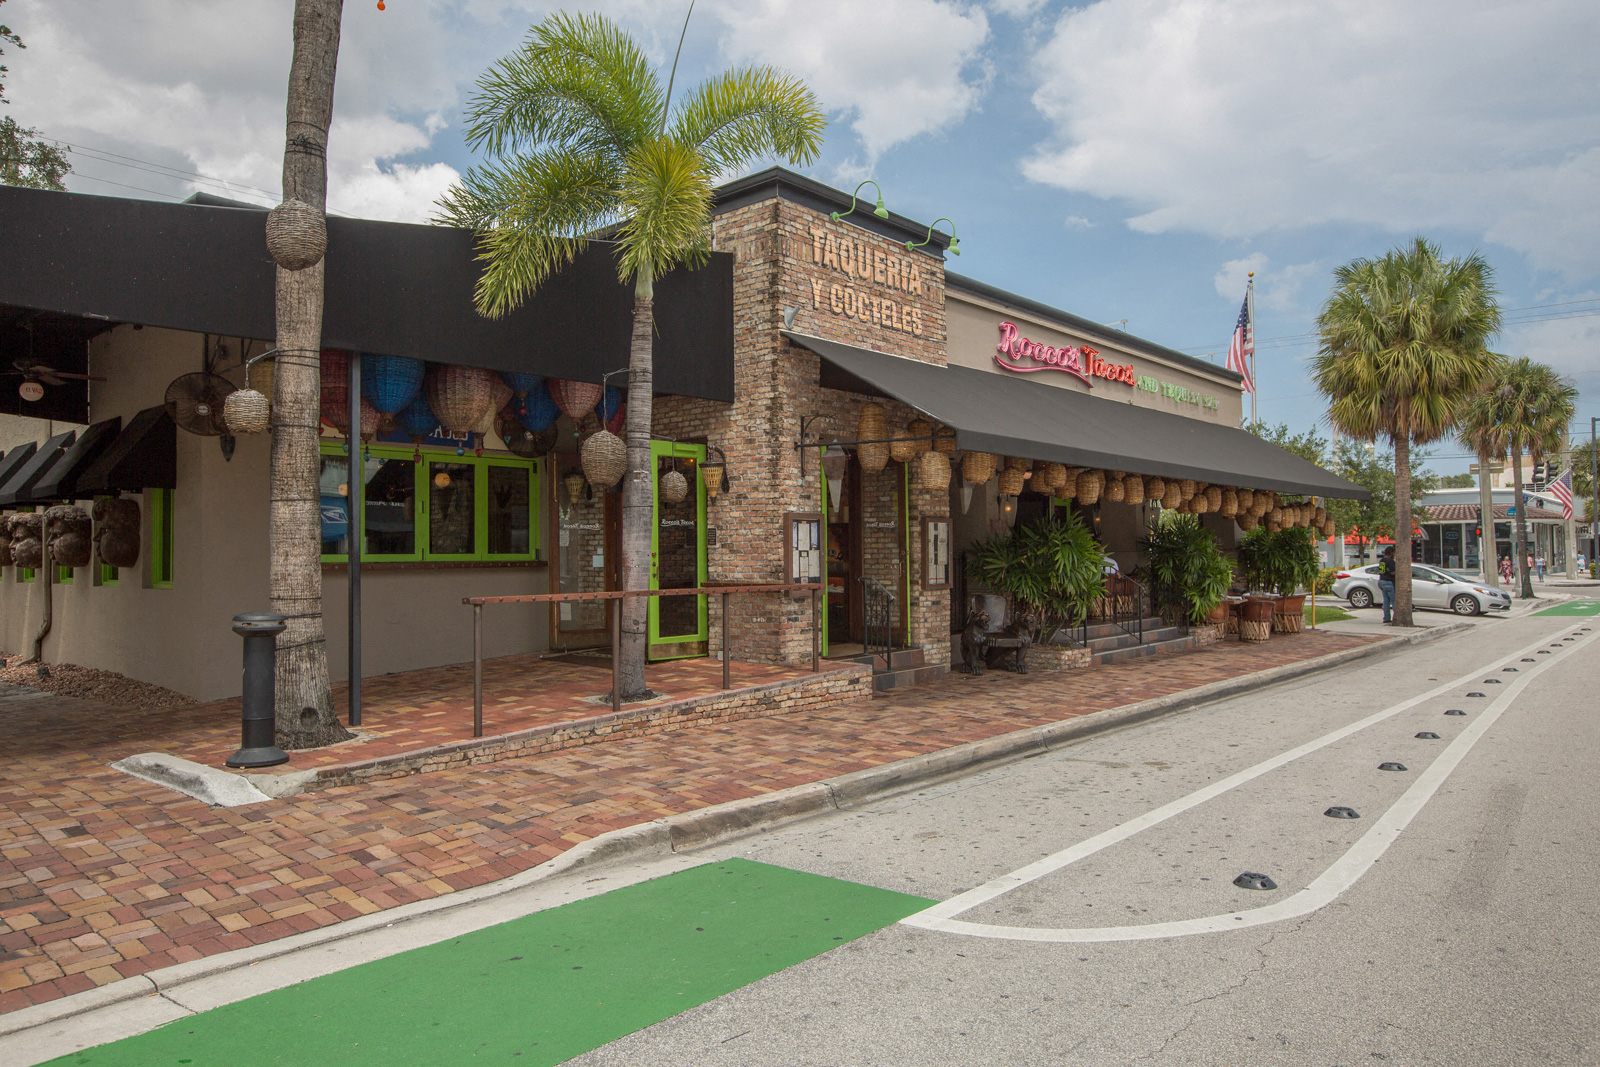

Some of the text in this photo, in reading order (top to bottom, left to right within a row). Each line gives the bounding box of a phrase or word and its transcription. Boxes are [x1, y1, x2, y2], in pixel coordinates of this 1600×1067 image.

[808, 225, 922, 297] TAQUERIA
[809, 277, 823, 310] Y
[997, 321, 1084, 373] Rocco's
[1080, 345, 1137, 387] Tacos
[1136, 375, 1159, 393] AND
